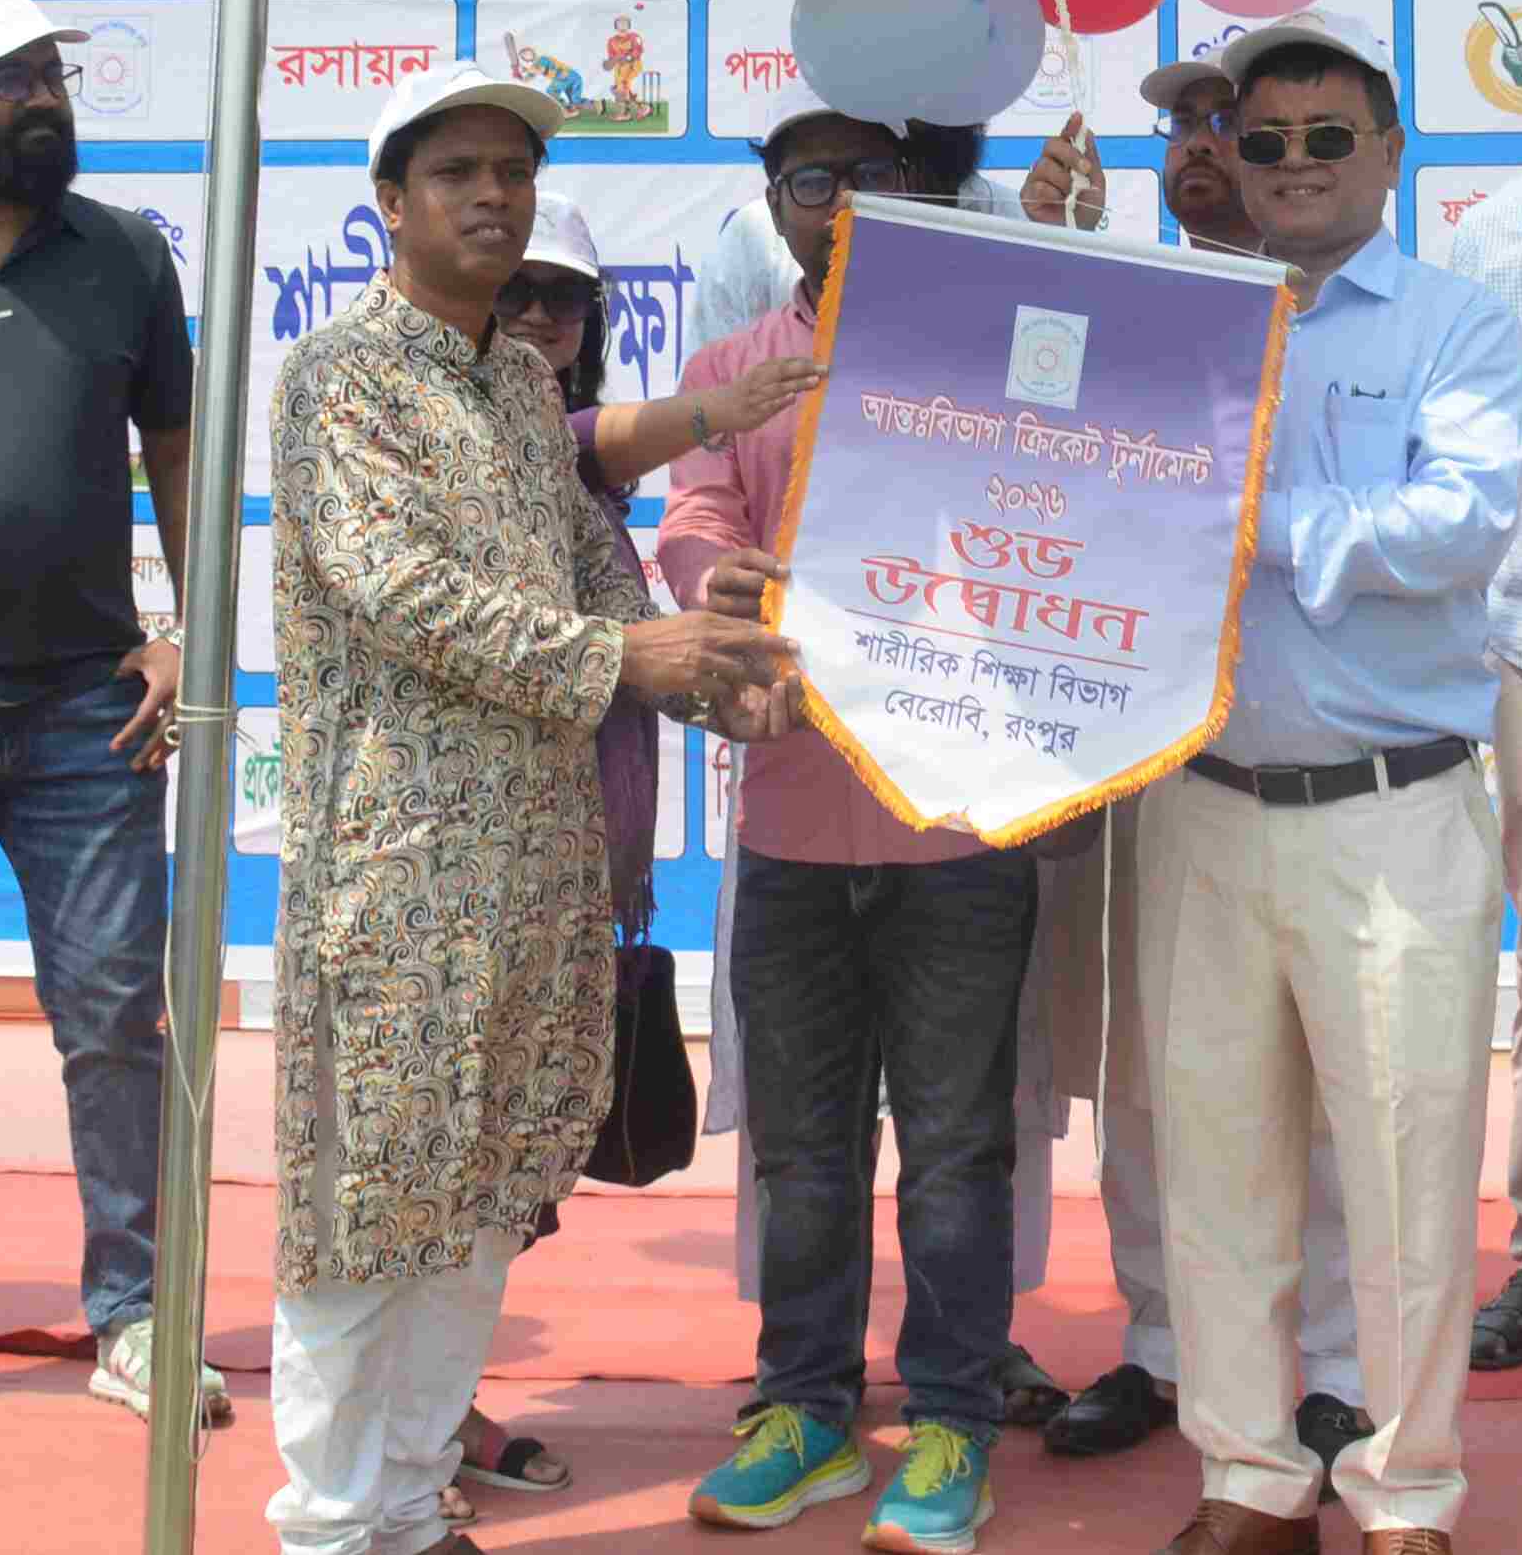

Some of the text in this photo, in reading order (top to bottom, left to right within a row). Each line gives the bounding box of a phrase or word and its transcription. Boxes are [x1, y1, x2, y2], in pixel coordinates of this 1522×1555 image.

[272, 40, 438, 87] রসায়ন
[860, 392, 1214, 492] আন্তঃবিভাগ ক্রিকেট টুর্নামেন্ট
[985, 473, 1066, 525] ২০২৬
[949, 517, 1084, 580] শুভ
[860, 555, 1150, 653] উদ্বোধন
[854, 629, 1133, 715] শারীরিক শিক্ষা বিভাগ
[885, 690, 1080, 758] বেরোবি, রংপুর
